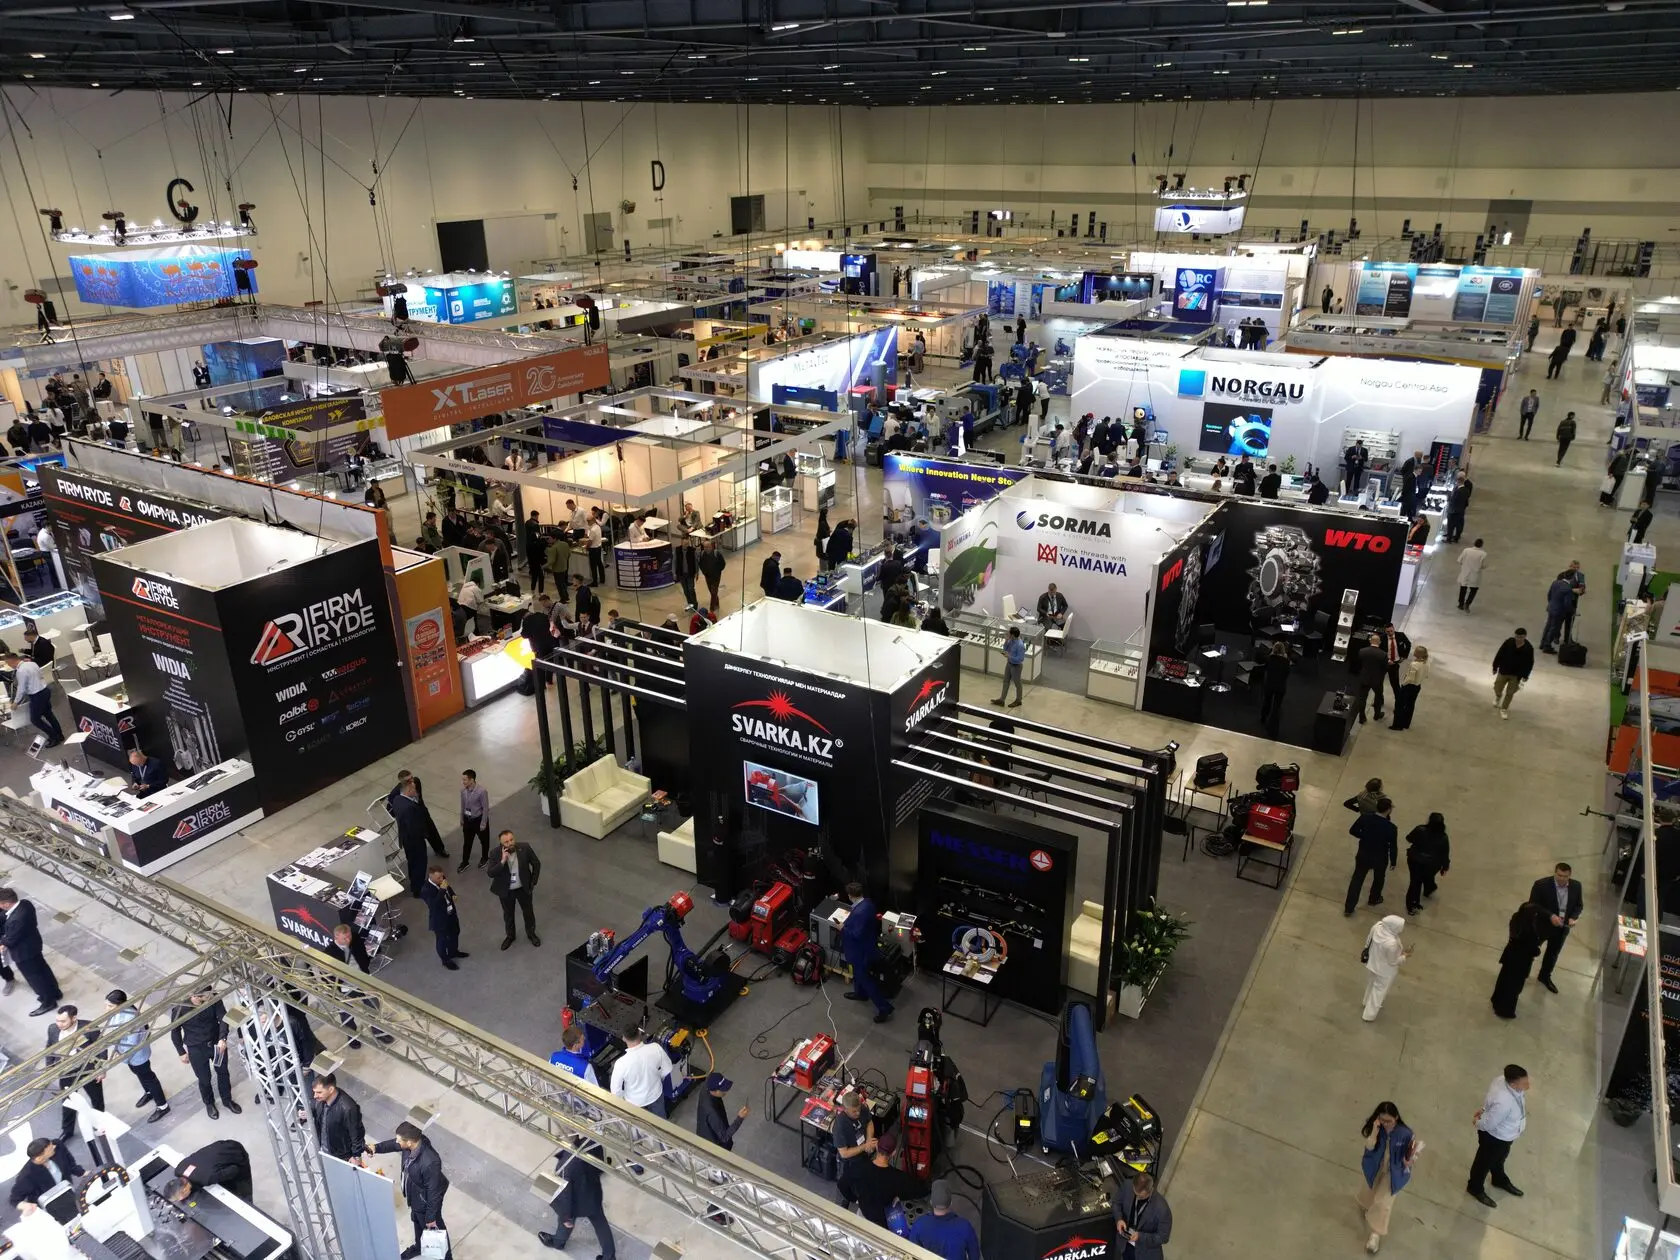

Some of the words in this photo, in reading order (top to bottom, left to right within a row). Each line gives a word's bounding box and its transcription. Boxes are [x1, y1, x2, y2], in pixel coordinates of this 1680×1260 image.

[651, 160, 665, 191] D
[1211, 376, 1304, 399] NORGAU
[1360, 377, 1393, 389] Norgau
[898, 464, 924, 475] Where
[926, 467, 969, 480] Innovation
[970, 473, 996, 484] Never
[997, 478, 1015, 486] Sto
[57, 479, 83, 499] FIRM
[85, 487, 114, 507] RYDE
[137, 500, 180, 525] ФИРМА
[1036, 513, 1112, 539] SORMA
[1324, 528, 1391, 554] WTO
[1059, 553, 1128, 577] YAMAWA
[1060, 546, 1079, 554] Think
[1080, 549, 1109, 560] threads
[1111, 553, 1127, 563] with
[1161, 558, 1183, 592] WTO
[152, 581, 173, 597] FIRM
[154, 594, 179, 610] RYDE
[309, 588, 364, 625] FIRM
[312, 604, 376, 645] RYDE
[152, 652, 191, 680] WIDIA
[266, 653, 306, 674] ИНСТРУМЕНТ
[308, 641, 339, 658] ОСНАСТКА
[275, 682, 308, 703] WIDIA
[279, 702, 308, 725] palbit
[905, 687, 947, 733] SVARKA.KZ
[345, 716, 368, 732] KORLOY
[731, 713, 833, 759] SVARKA.KZ
[739, 736, 768, 749] СВАРОЧНЫЕ
[803, 755, 834, 768] МАТЕРИАЛЫ
[199, 800, 225, 818] FIRM
[201, 806, 231, 825] RYDE
